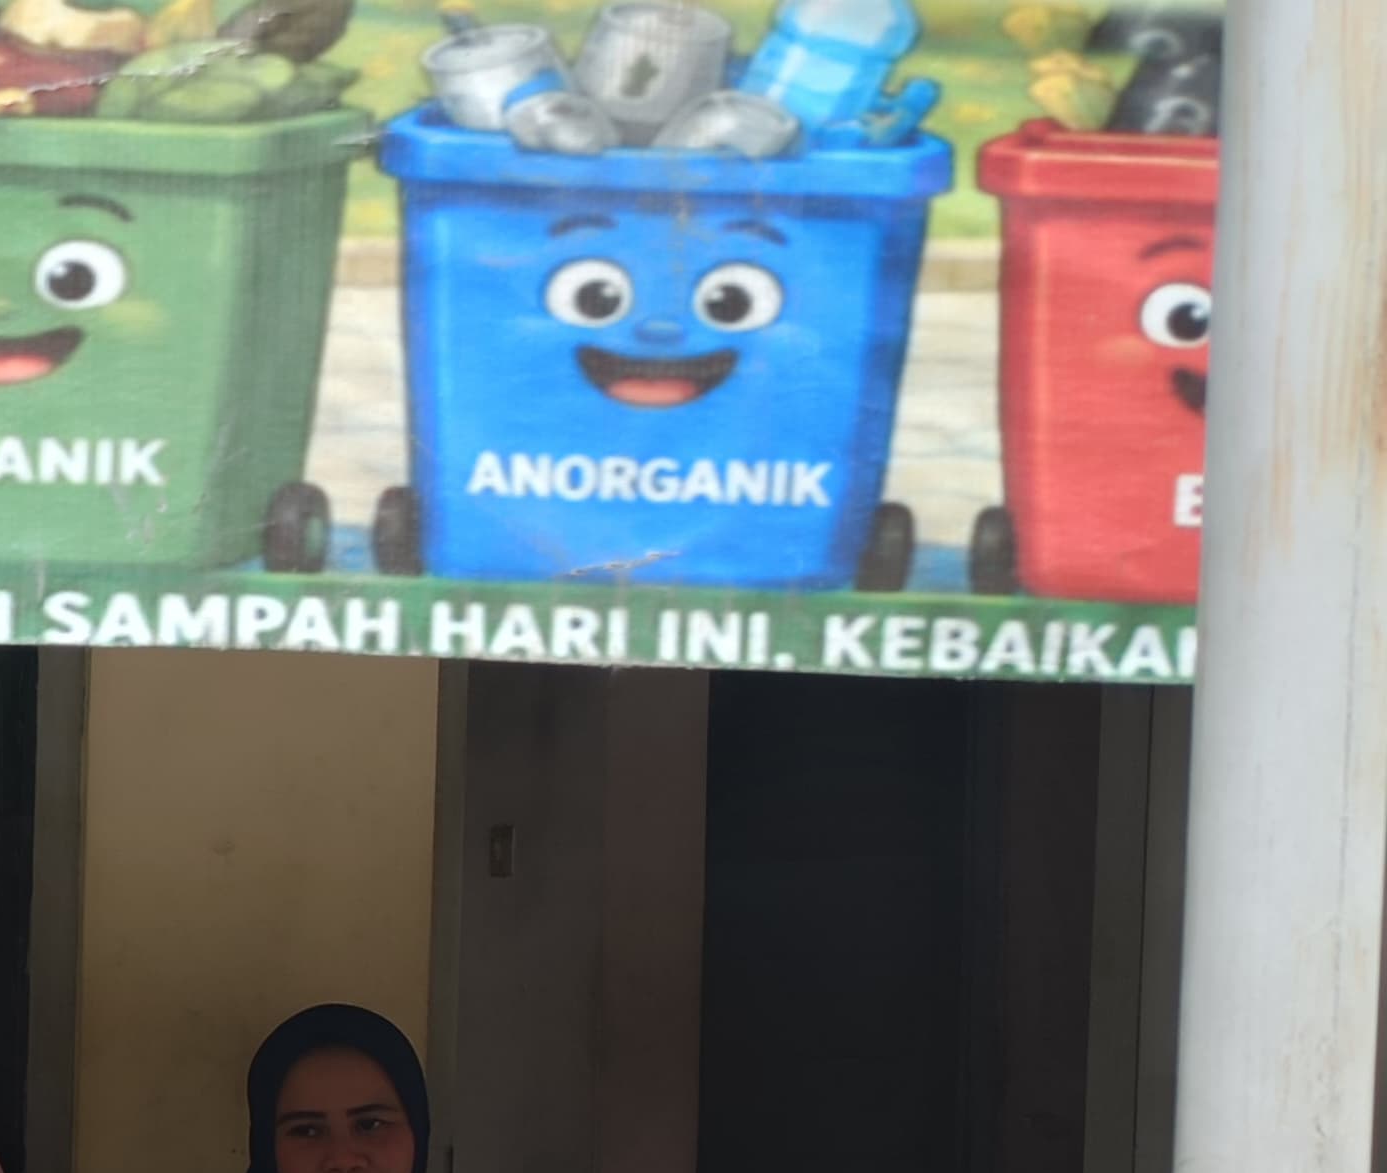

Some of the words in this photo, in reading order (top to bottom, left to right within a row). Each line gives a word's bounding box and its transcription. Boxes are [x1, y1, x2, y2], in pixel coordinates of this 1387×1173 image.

[467, 452, 832, 508] ANORGANIK
[42, 591, 400, 656] SAMPAH
[430, 602, 628, 663] HARI
